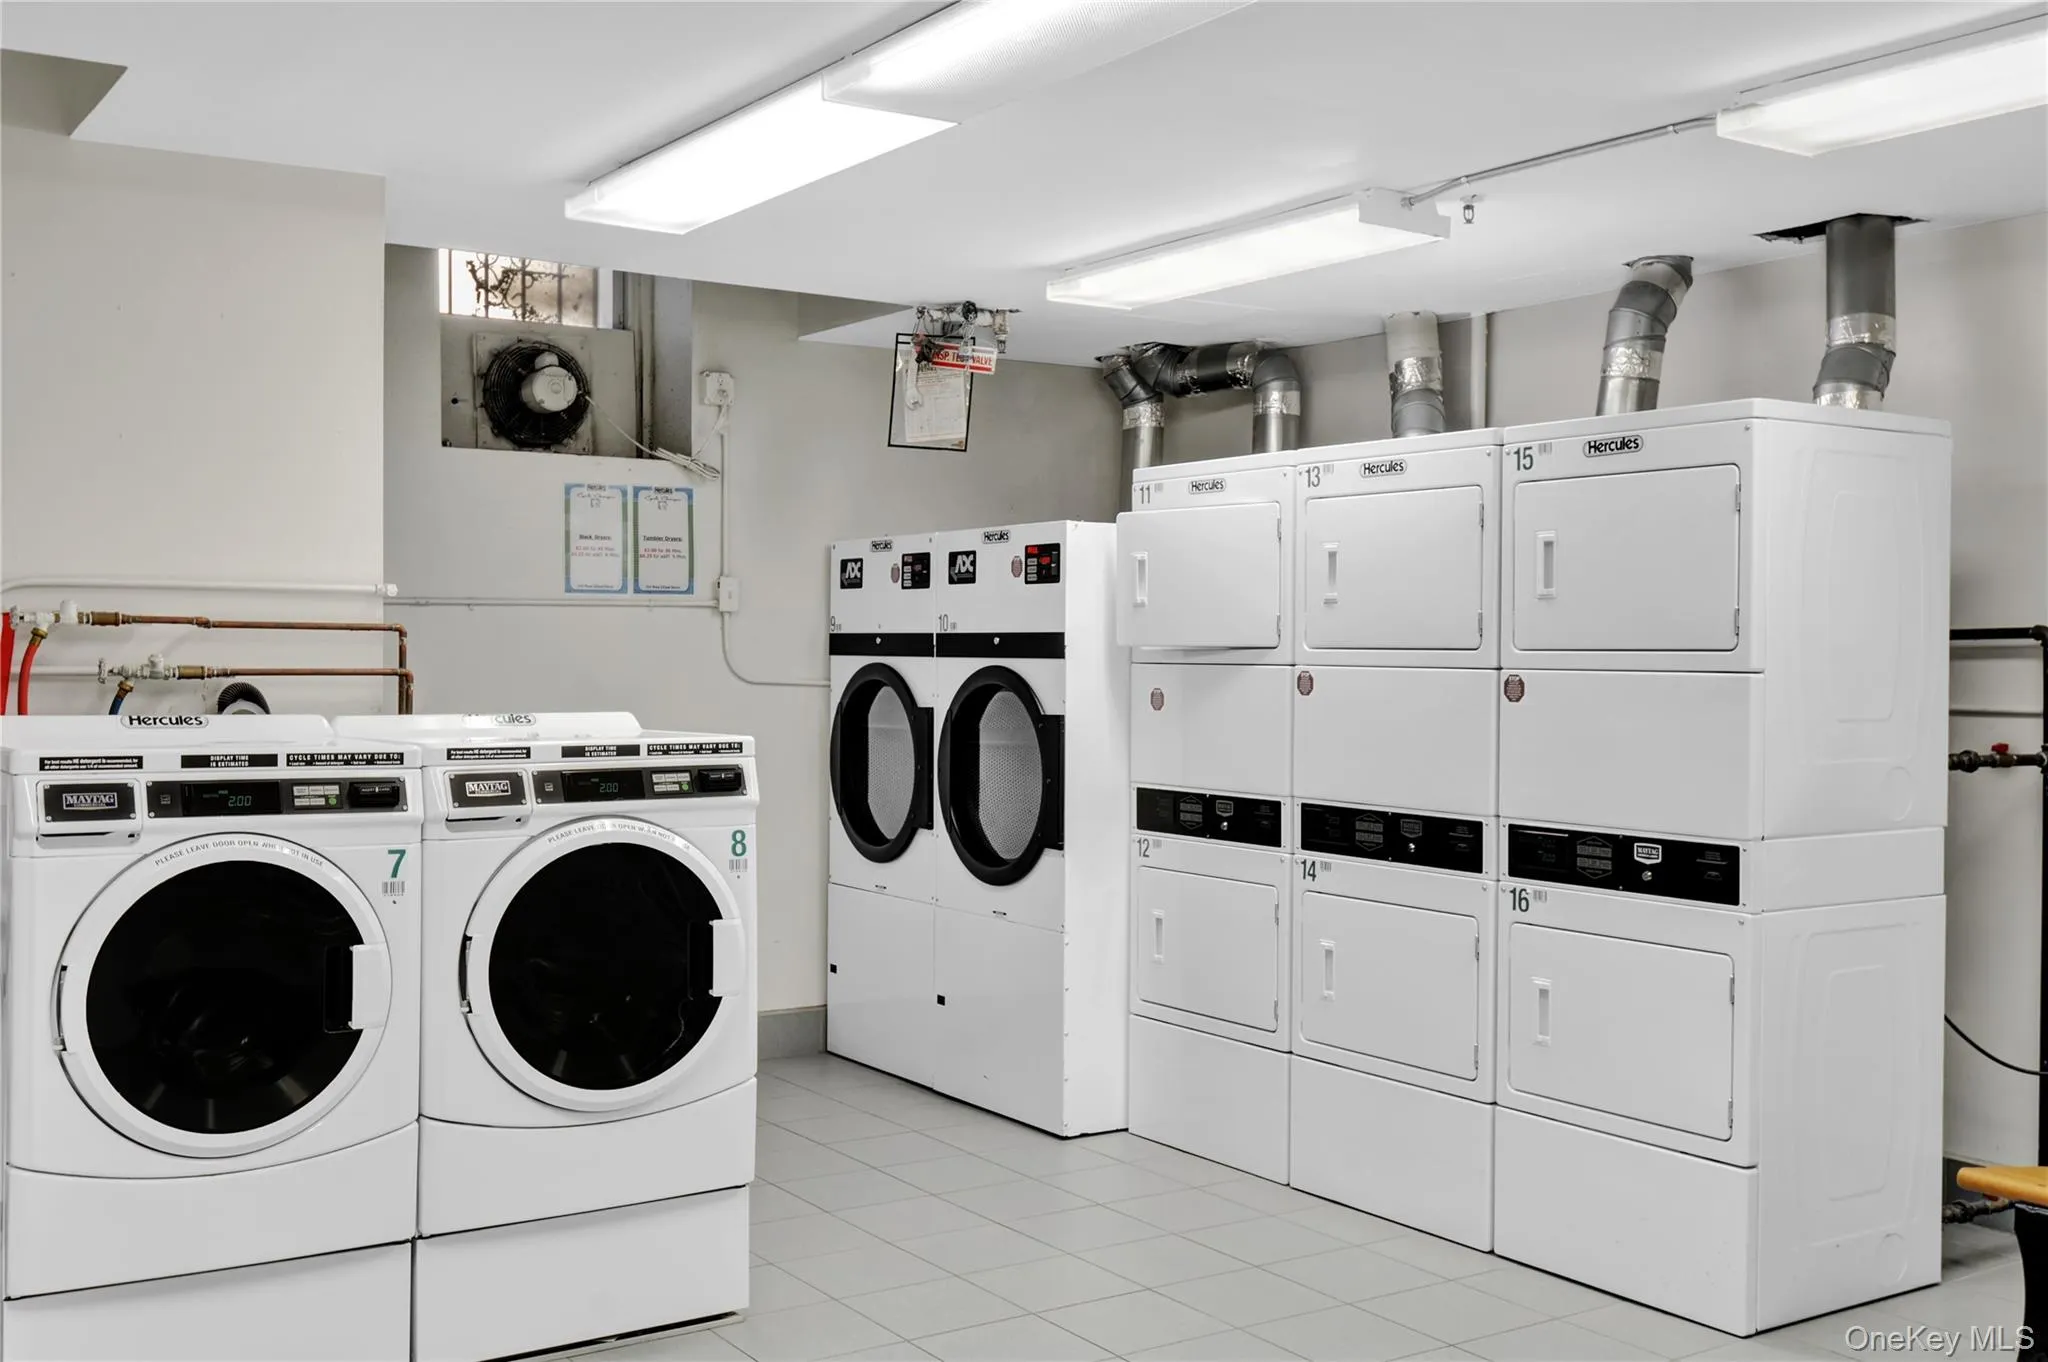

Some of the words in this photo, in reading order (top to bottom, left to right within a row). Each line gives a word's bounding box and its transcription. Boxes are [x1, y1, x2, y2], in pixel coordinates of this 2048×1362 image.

[971, 354, 993, 366] VALVE
[1588, 436, 1639, 454] Hercules
[1513, 446, 1534, 471] 15
[1364, 460, 1404, 476] Hercules
[1191, 478, 1224, 492] Hercules
[1305, 466, 1320, 488] 13
[1140, 485, 1150, 504] 11
[984, 530, 1009, 542] Hercules
[871, 540, 892, 550] Hercules
[830, 616, 836, 632] 9
[938, 614, 949, 632] 10
[128, 715, 203, 726] Hercules
[468, 783, 508, 792] MAYTAG
[600, 783, 618, 792] 2.00
[66, 795, 114, 804] MAYTAG
[228, 796, 252, 806] 2.00
[548, 831, 572, 844] PLEASE
[574, 824, 594, 834] LEAVE
[638, 826, 657, 835] WEN
[731, 830, 747, 857] 8
[1137, 838, 1150, 858] 12
[1637, 846, 1658, 855] MAYTAG
[155, 851, 184, 866] PLEASE
[186, 843, 210, 855] LEAVE
[212, 840, 236, 848] DOOR
[301, 852, 310, 860] IN
[310, 856, 323, 866] USE
[388, 849, 406, 878] 7
[1301, 859, 1316, 882] 14
[1509, 887, 1530, 912] 16
